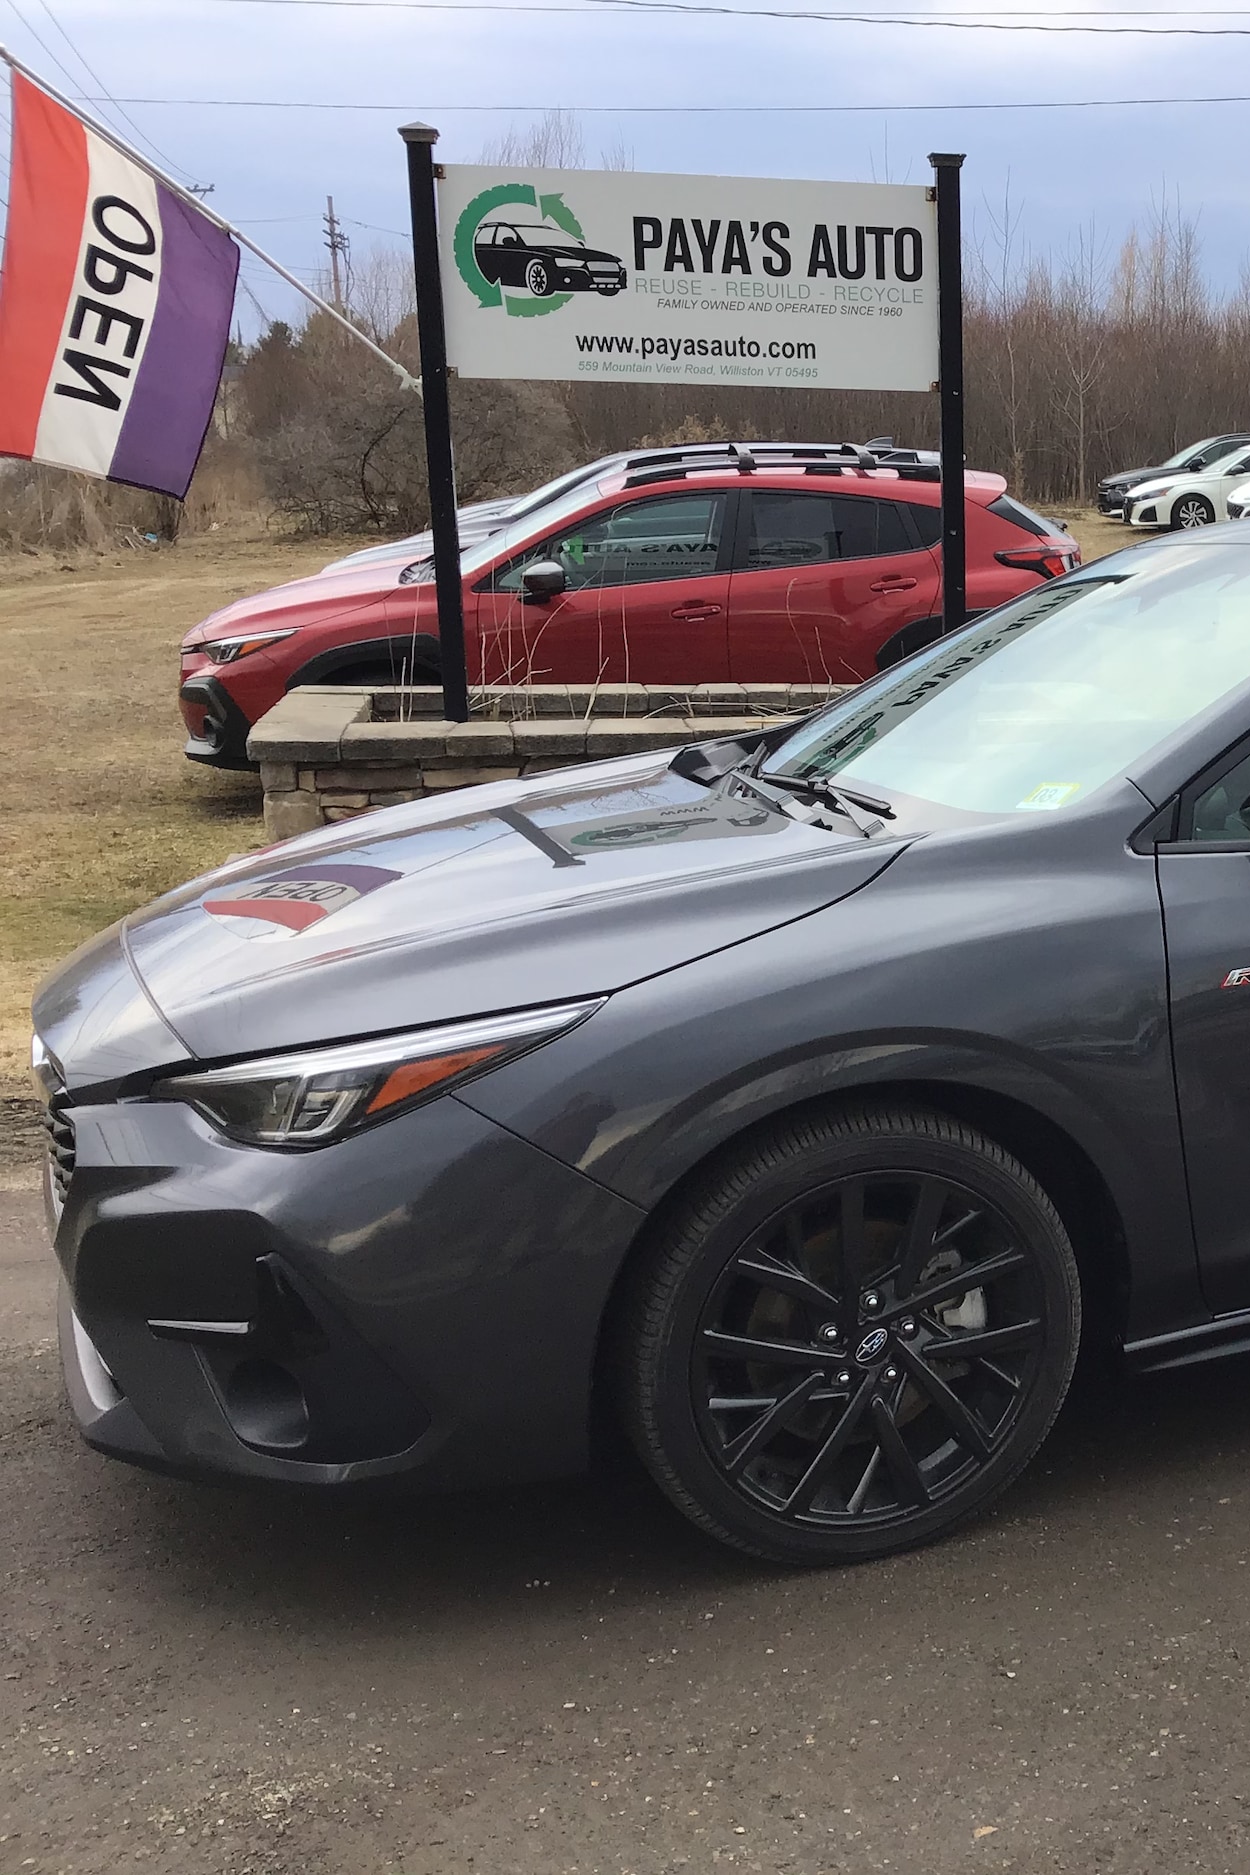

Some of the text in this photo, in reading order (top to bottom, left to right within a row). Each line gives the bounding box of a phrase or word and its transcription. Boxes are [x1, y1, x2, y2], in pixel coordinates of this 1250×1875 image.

[633, 216, 923, 282] PAYA'S AUTO
[635, 278, 702, 295] REUSE
[726, 281, 811, 299] REBUILD
[834, 285, 924, 304] RECYCLE
[657, 298, 903, 317] FAMILY OWNED AND OPERATED SINCE 1960
[575, 335, 816, 360] www.payasauto.com
[578, 361, 818, 378] 559 Mountain View Road, Williston VT 05495
